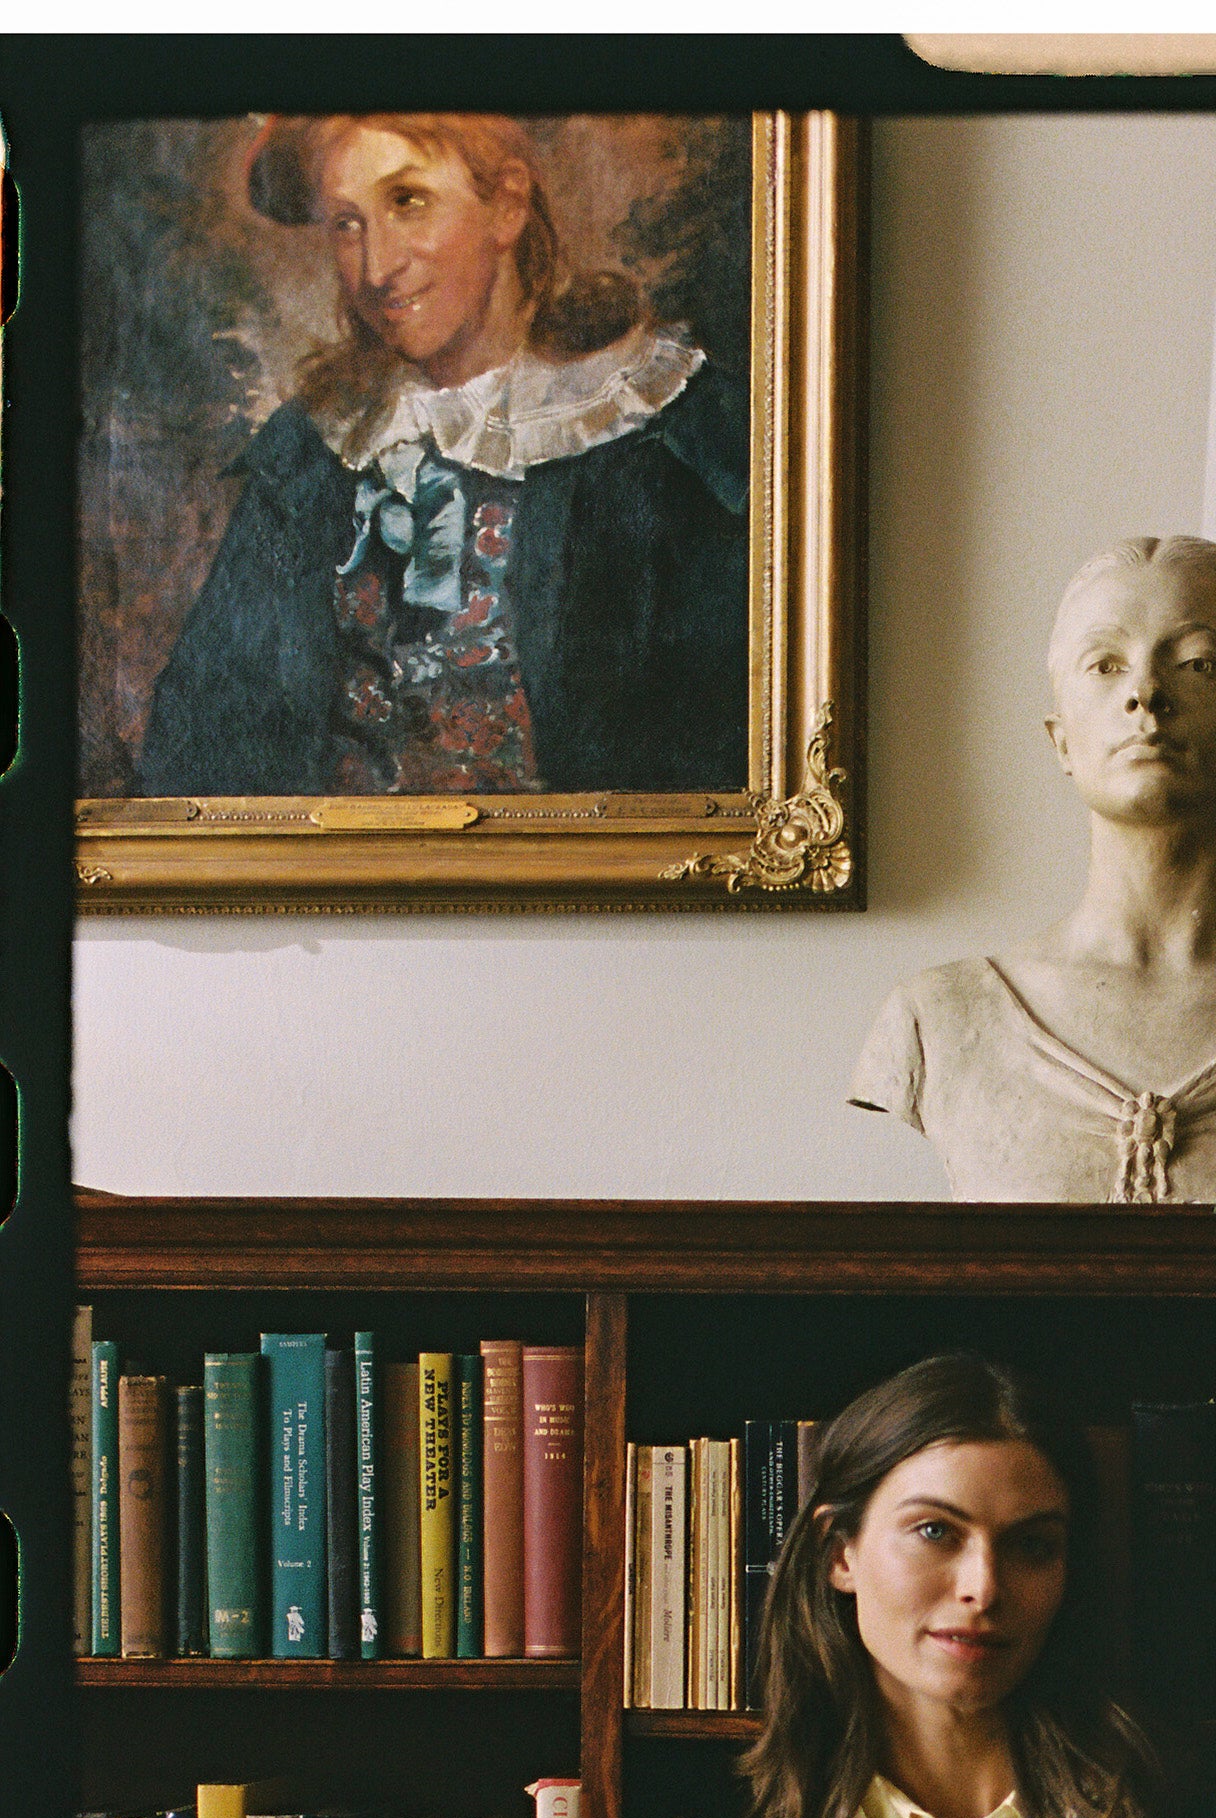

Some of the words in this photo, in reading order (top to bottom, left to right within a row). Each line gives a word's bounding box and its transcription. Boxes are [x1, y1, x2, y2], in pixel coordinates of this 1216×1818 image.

[100, 1359, 108, 1408] APPLAUSE
[360, 1359, 373, 1392] Latin
[424, 1368, 436, 1411] NEW
[283, 1408, 292, 1422] To
[297, 1400, 308, 1419] The
[437, 1381, 449, 1438] PLAYS
[534, 1403, 557, 1412] WHO'S
[539, 1416, 548, 1424] IN
[282, 1426, 293, 1451] Plays
[297, 1423, 308, 1454] Drama
[360, 1396, 374, 1458] American
[534, 1428, 548, 1436] AND
[283, 1453, 293, 1471] and
[425, 1417, 436, 1510] THEATER
[438, 1444, 449, 1482] FOR
[776, 1440, 784, 1459] THE
[297, 1457, 308, 1501] Scholars'
[361, 1462, 375, 1490] Play
[461, 1481, 473, 1500] AND
[776, 1462, 784, 1511] BEGGAR'S
[282, 1474, 293, 1525] Filmscripts
[438, 1486, 450, 1499] A
[664, 1485, 673, 1499] THE
[297, 1503, 307, 1530] Index
[362, 1493, 376, 1529] Index
[100, 1524, 108, 1556] PLAYS
[664, 1503, 673, 1559] MISANTHROPE
[776, 1513, 784, 1546] OPERA
[100, 1557, 109, 1590] SHORT
[277, 1559, 304, 1568] Volume
[306, 1559, 312, 1568] 2
[433, 1566, 443, 1591] New
[100, 1592, 108, 1622] BEST
[434, 1595, 444, 1648] Directions
[100, 1622, 108, 1639] THE
